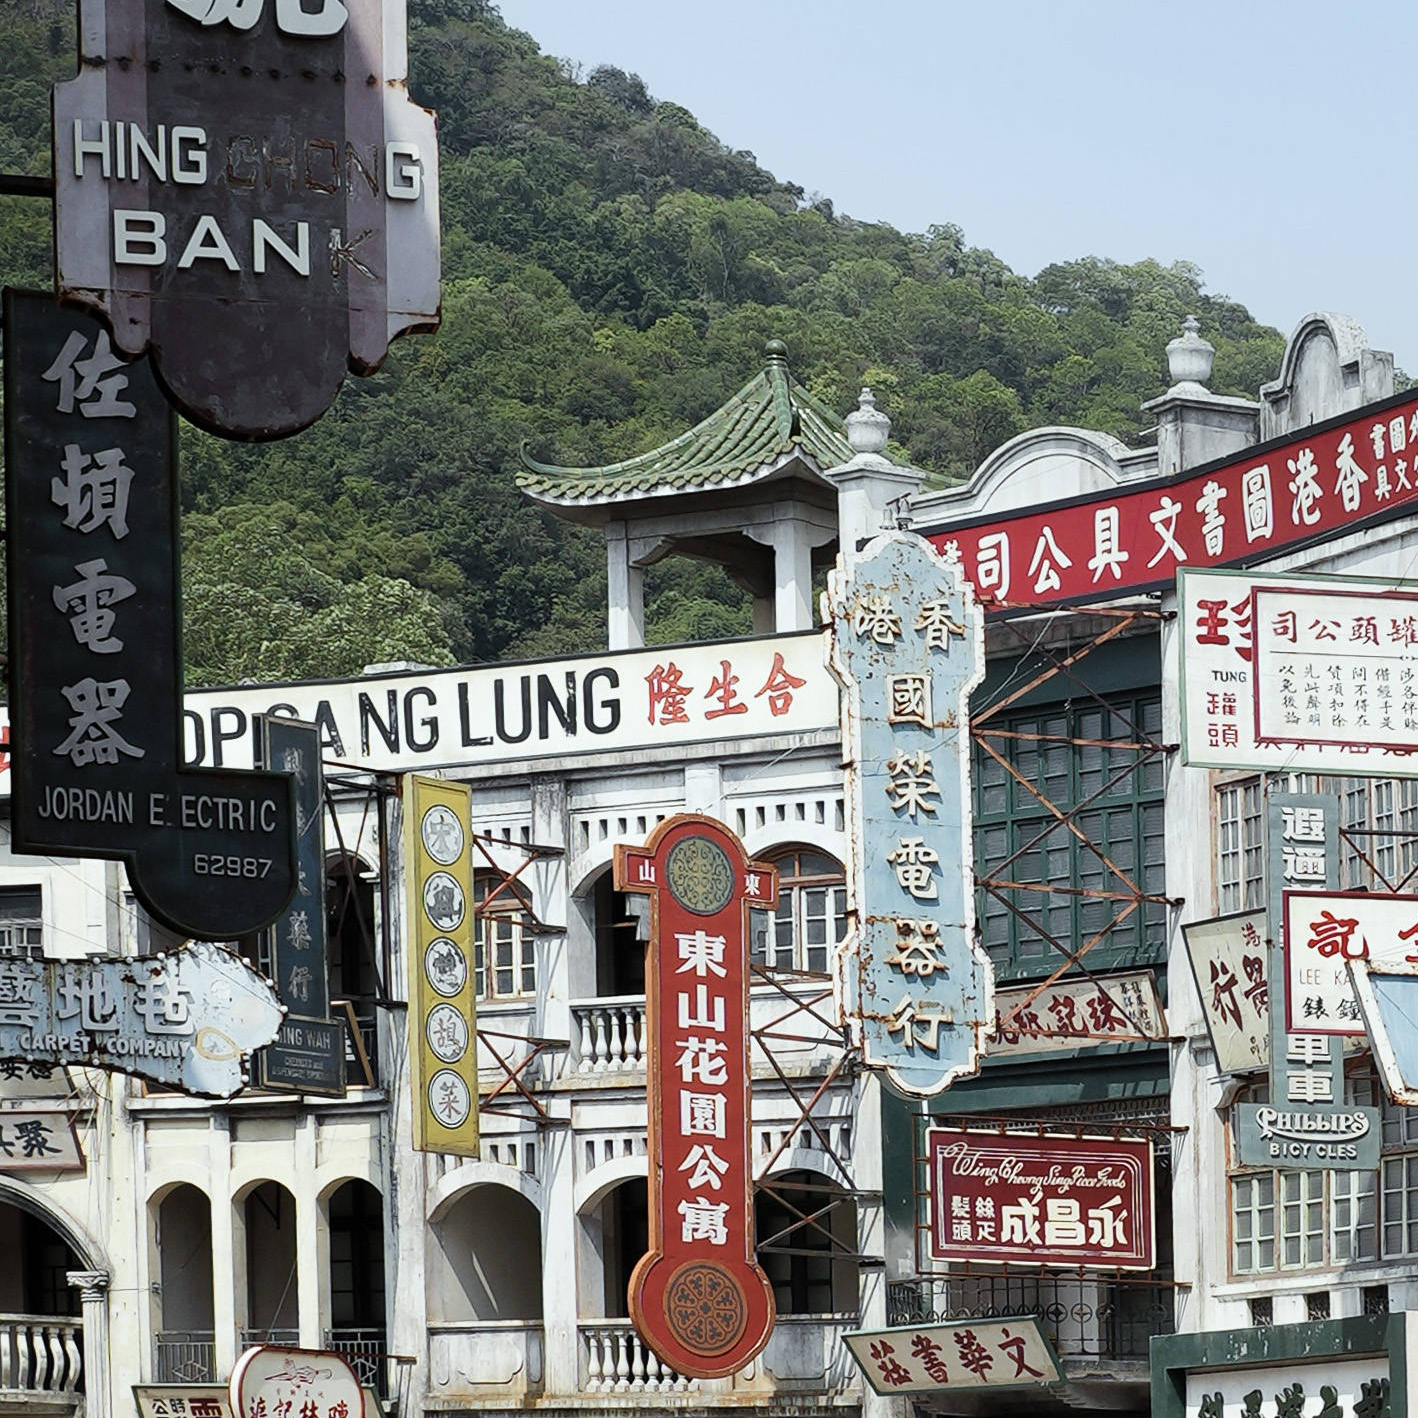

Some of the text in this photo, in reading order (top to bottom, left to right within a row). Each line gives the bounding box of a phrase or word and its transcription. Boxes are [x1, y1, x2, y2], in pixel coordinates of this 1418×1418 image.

[74, 119, 207, 185] HING
[114, 209, 378, 279] BANK
[976, 433, 1367, 601] 香港圖書文具公司
[42, 329, 145, 767] 佐頓電器
[854, 596, 964, 652] 香港
[644, 652, 807, 726] 合生隆
[1211, 670, 1247, 683] TUNG
[458, 667, 621, 747] LUNG
[38, 786, 276, 833] JORDAN EECTRIC
[194, 854, 272, 880] 62987
[1299, 969, 1320, 985] LEE
[20, 1033, 191, 1059] CARPET COMPANY
[307, 1030, 331, 1050] WAH
[673, 929, 729, 1246] 東山花園公寓
[1255, 1105, 1370, 1140] PHILLIPS
[944, 1142, 1000, 1186] Wing
[1001, 1188, 1129, 1248] 永昌成
